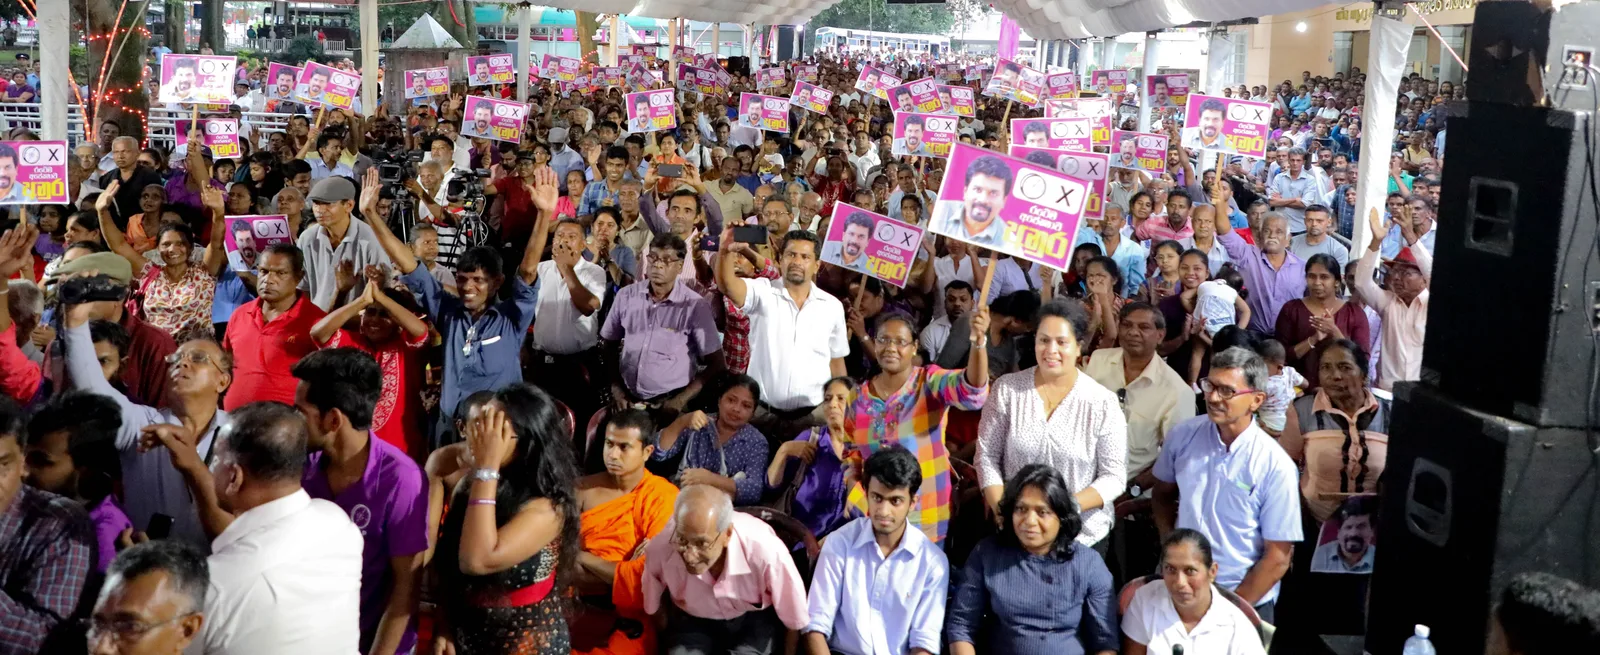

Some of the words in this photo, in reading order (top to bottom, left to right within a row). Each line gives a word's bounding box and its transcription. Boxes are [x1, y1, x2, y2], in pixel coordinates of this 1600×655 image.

[1224, 133, 1265, 154] අනුර
[22, 178, 65, 201] අනුර
[1003, 220, 1069, 260] අනුර
[865, 254, 908, 281] අනුර
